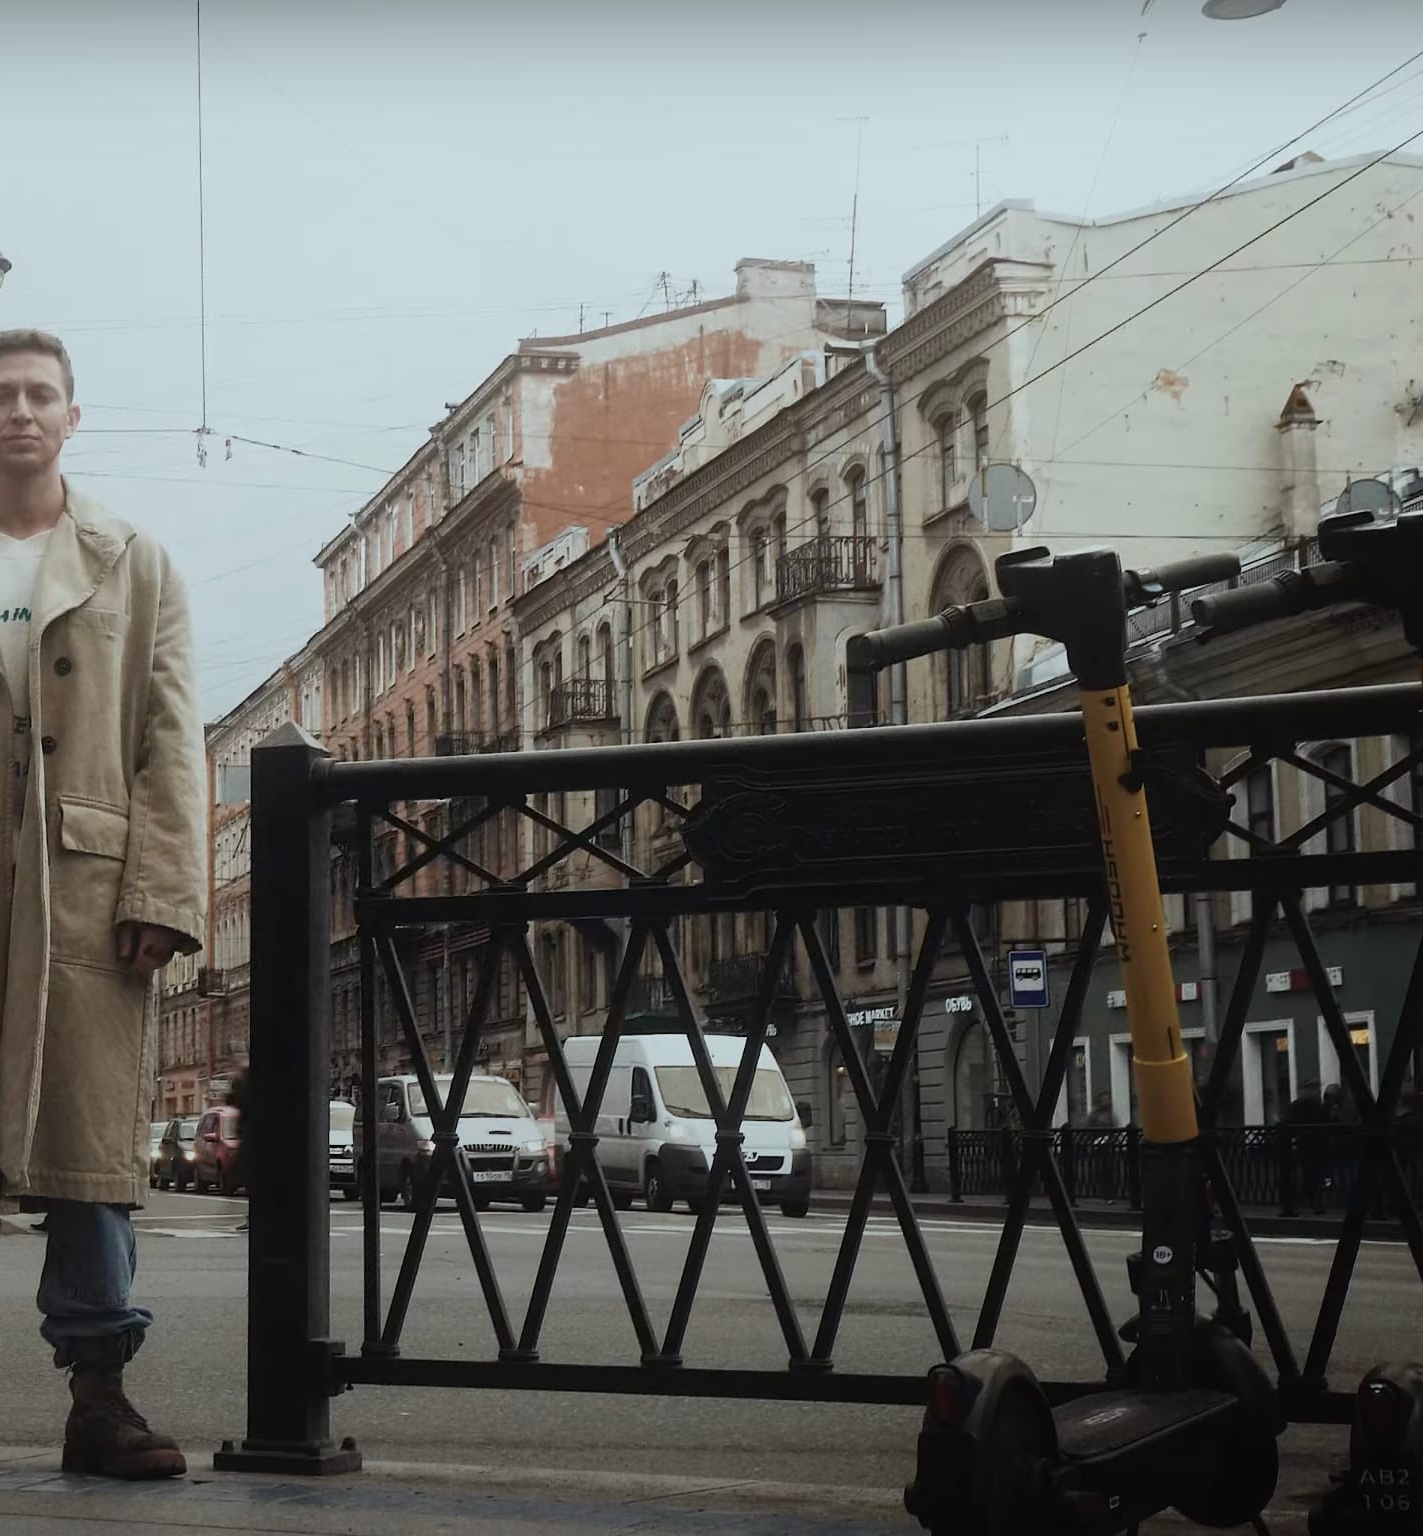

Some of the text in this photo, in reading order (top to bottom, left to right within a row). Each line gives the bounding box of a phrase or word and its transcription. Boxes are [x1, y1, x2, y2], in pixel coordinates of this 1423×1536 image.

[945, 995, 973, 1013] ОБУВЬ
[865, 1006, 895, 1025] MARKET
[1359, 1468, 1410, 1485] AB2
[1362, 1494, 1410, 1511] 106
